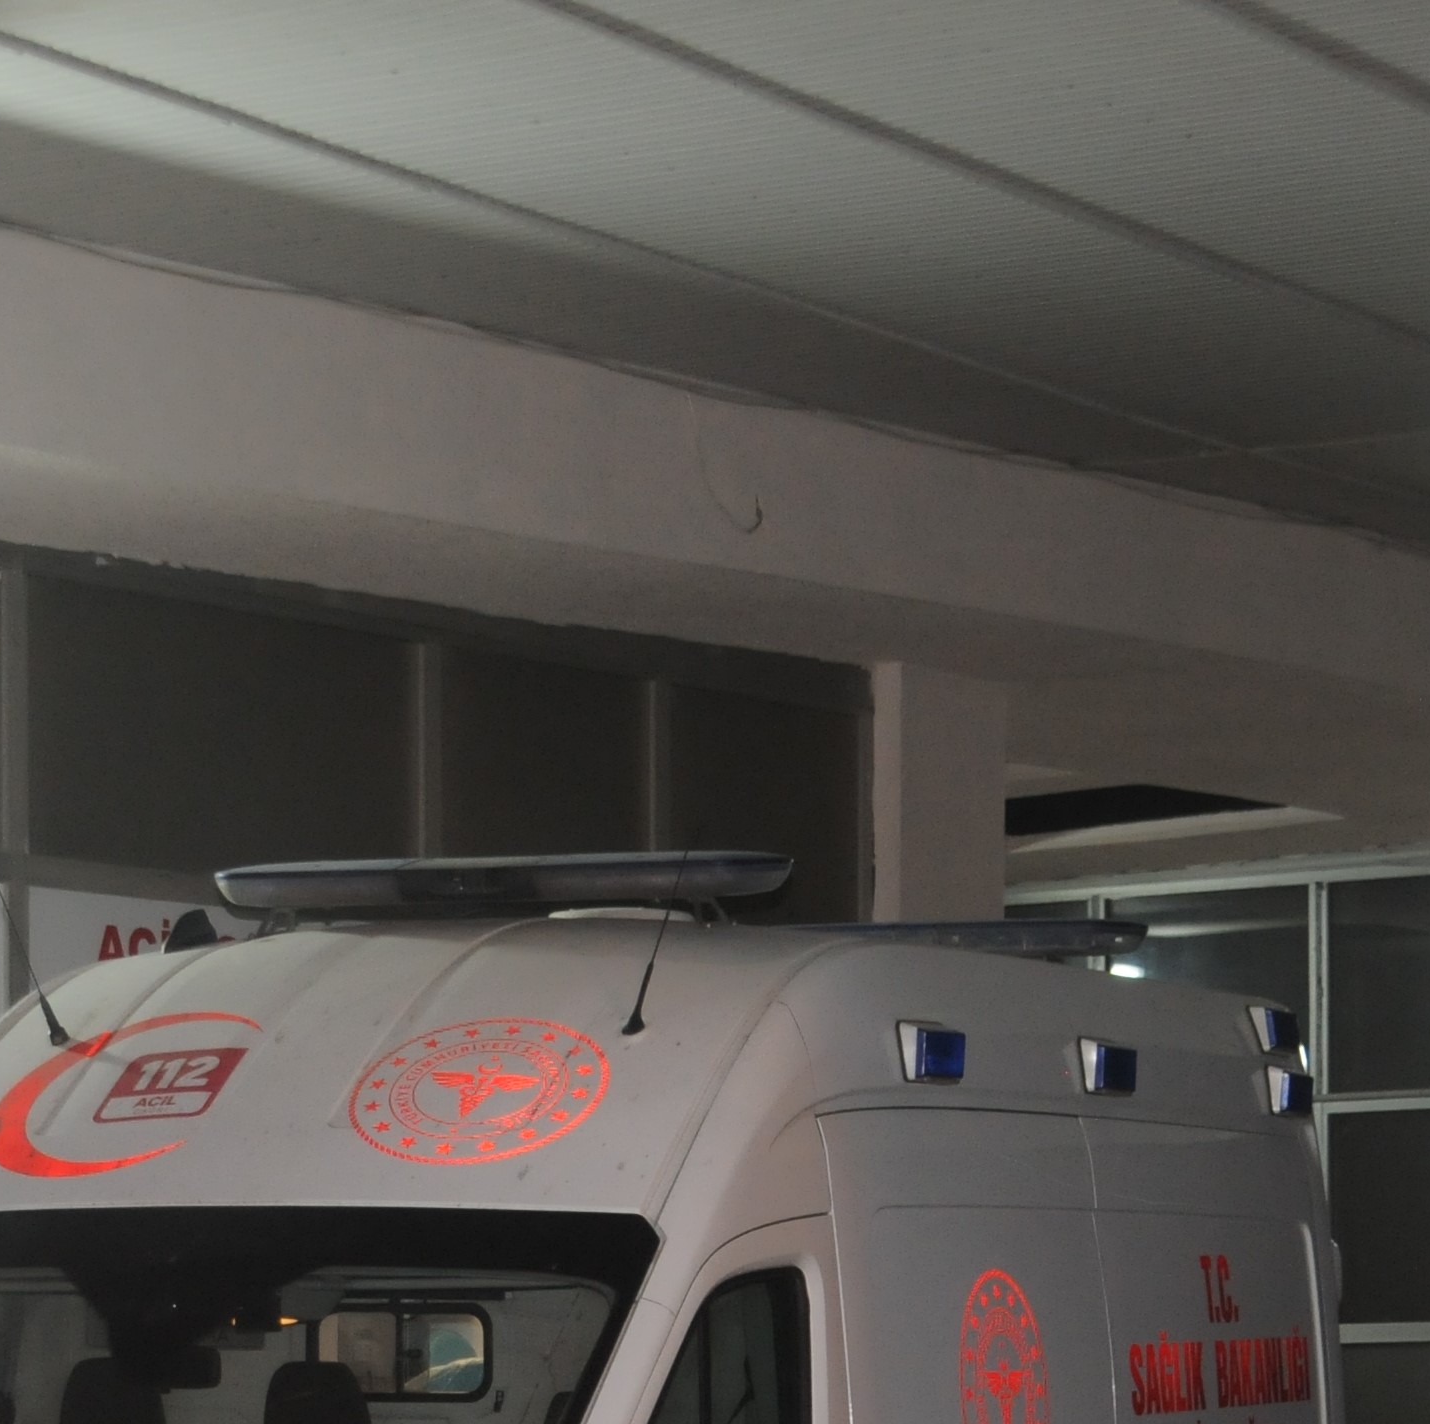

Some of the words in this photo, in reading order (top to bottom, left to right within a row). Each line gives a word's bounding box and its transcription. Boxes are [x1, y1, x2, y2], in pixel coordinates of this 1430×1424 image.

[133, 1056, 220, 1091] 112
[1199, 1255, 1239, 1323] T.C.
[1129, 1329, 1206, 1416] SAĞLIK
[1214, 1325, 1311, 1409] BAKANLIĞI
